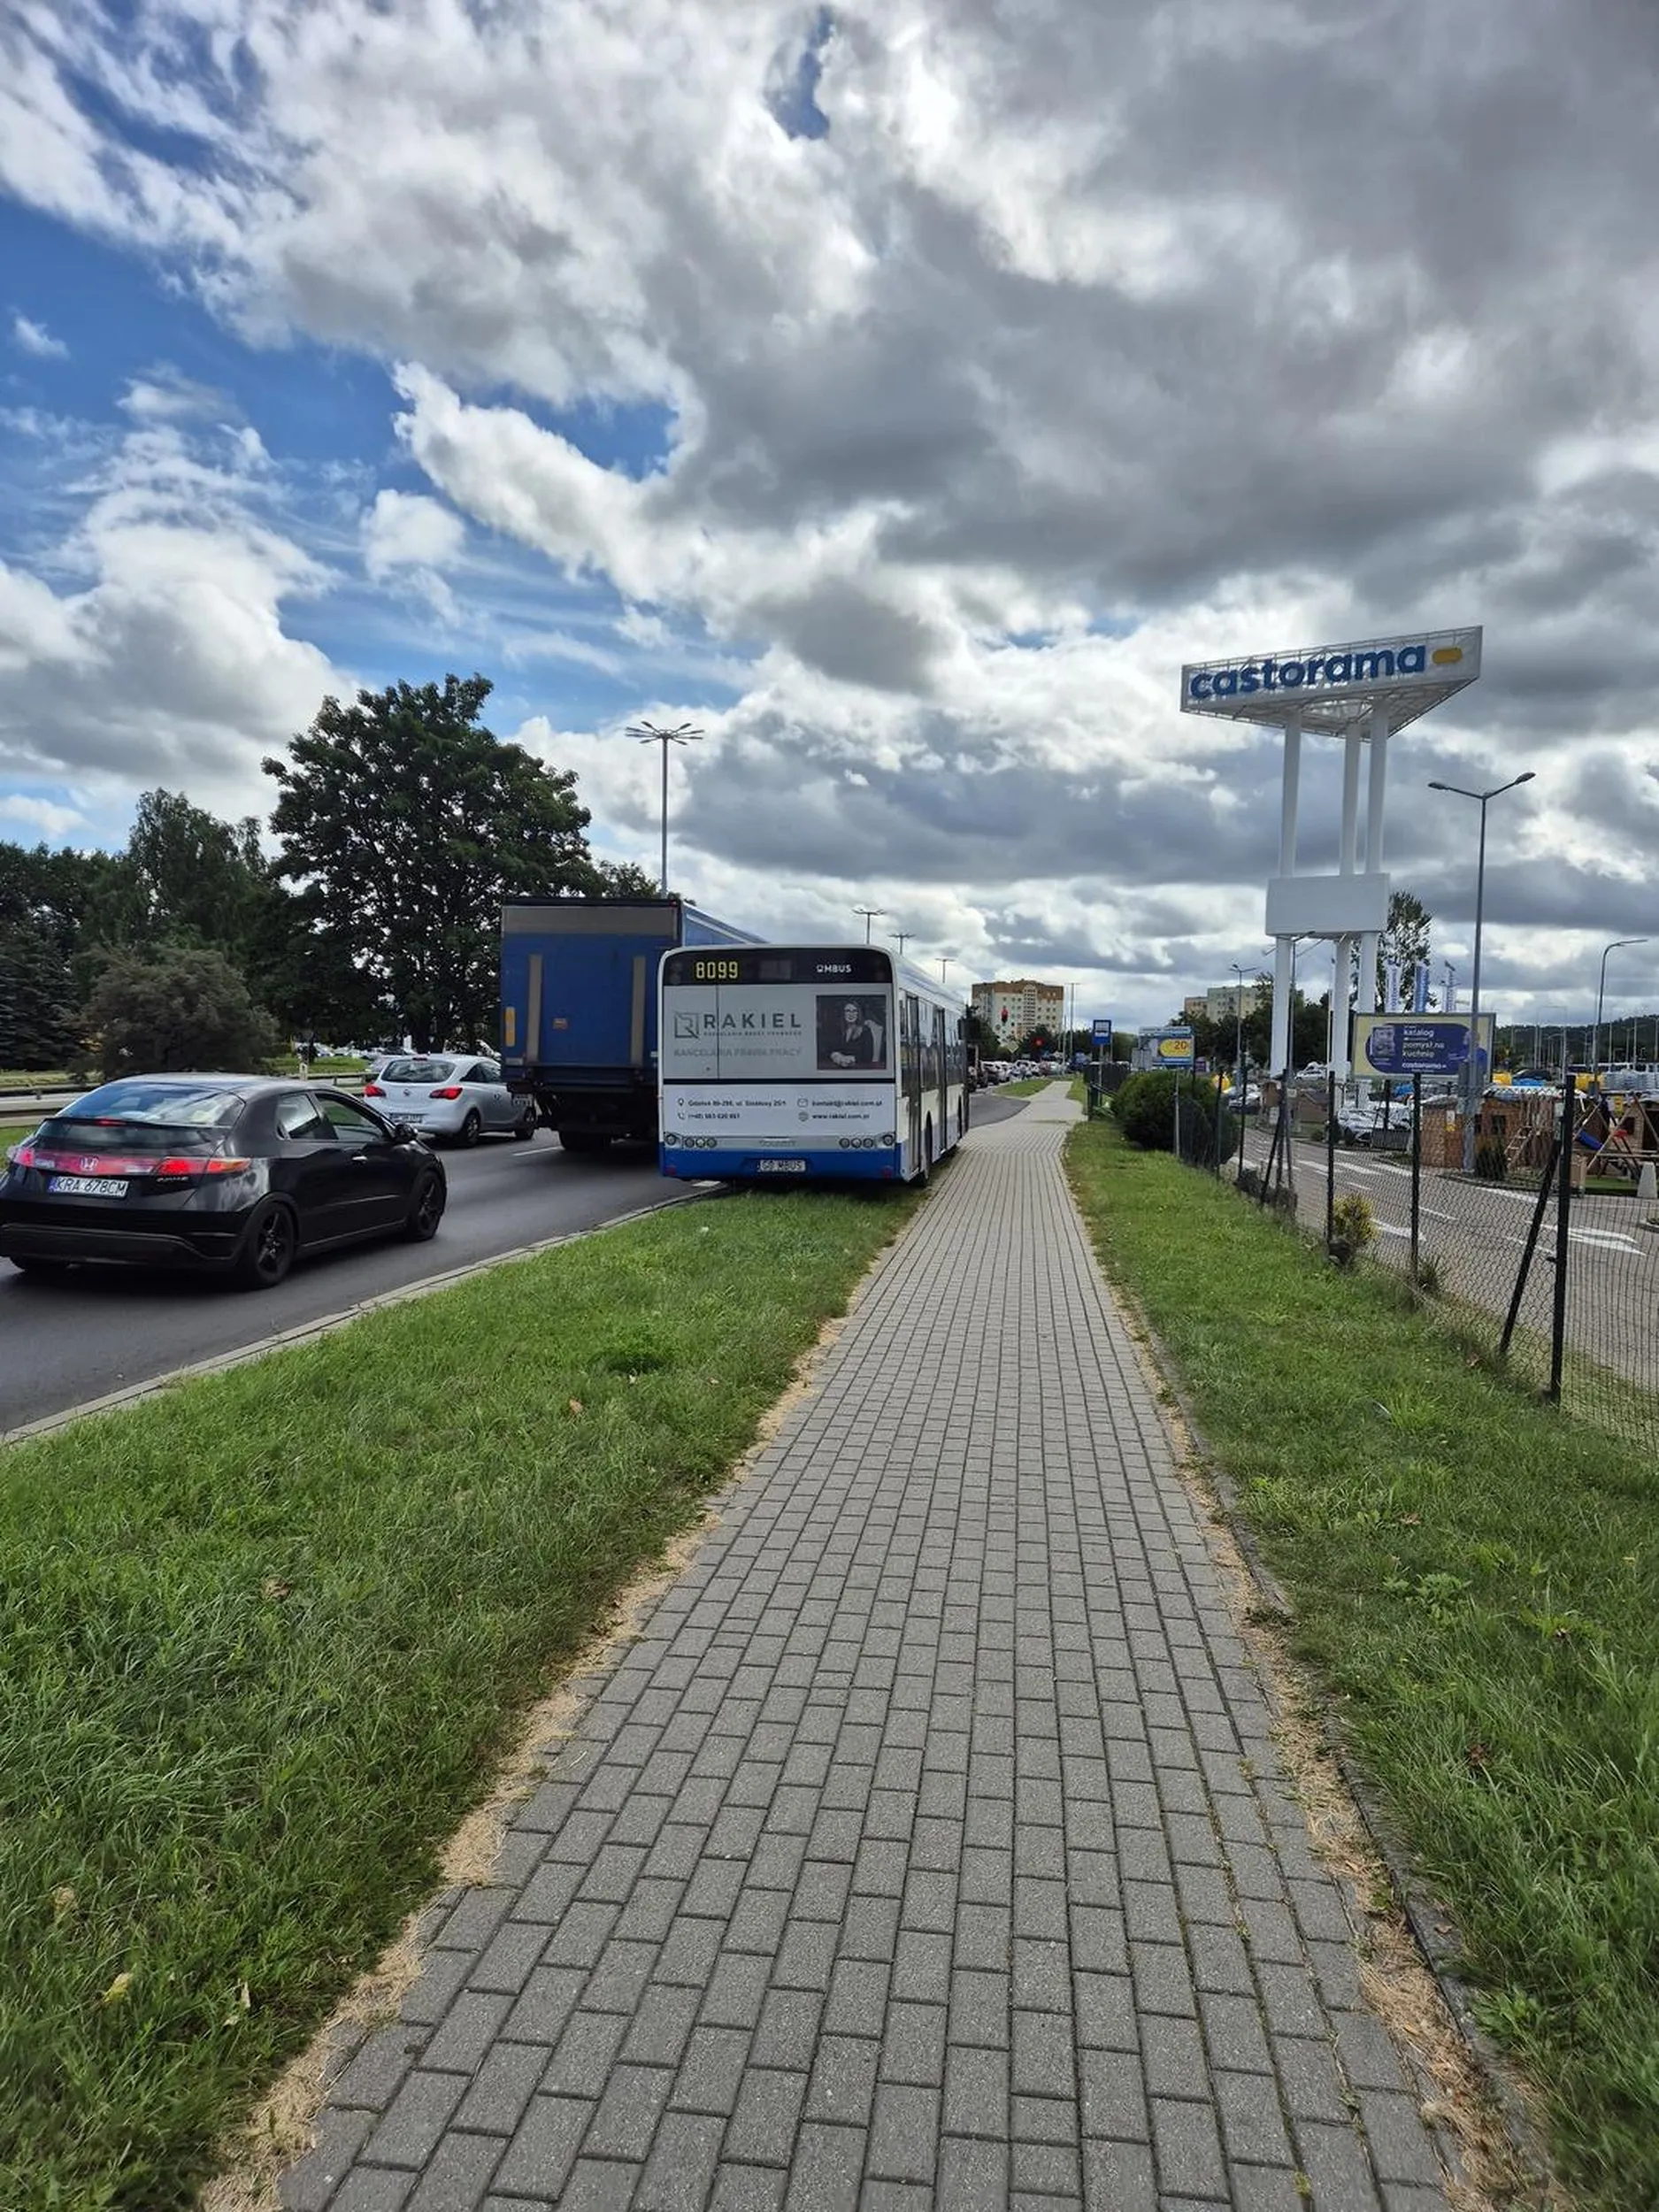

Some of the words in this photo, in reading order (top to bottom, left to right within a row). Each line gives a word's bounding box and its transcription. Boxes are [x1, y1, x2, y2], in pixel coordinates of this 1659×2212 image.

[1190, 644, 1427, 700] castorama
[695, 961, 738, 979] 8099
[703, 1013, 801, 1029] RAKIEL
[57, 1177, 80, 1191] KRA
